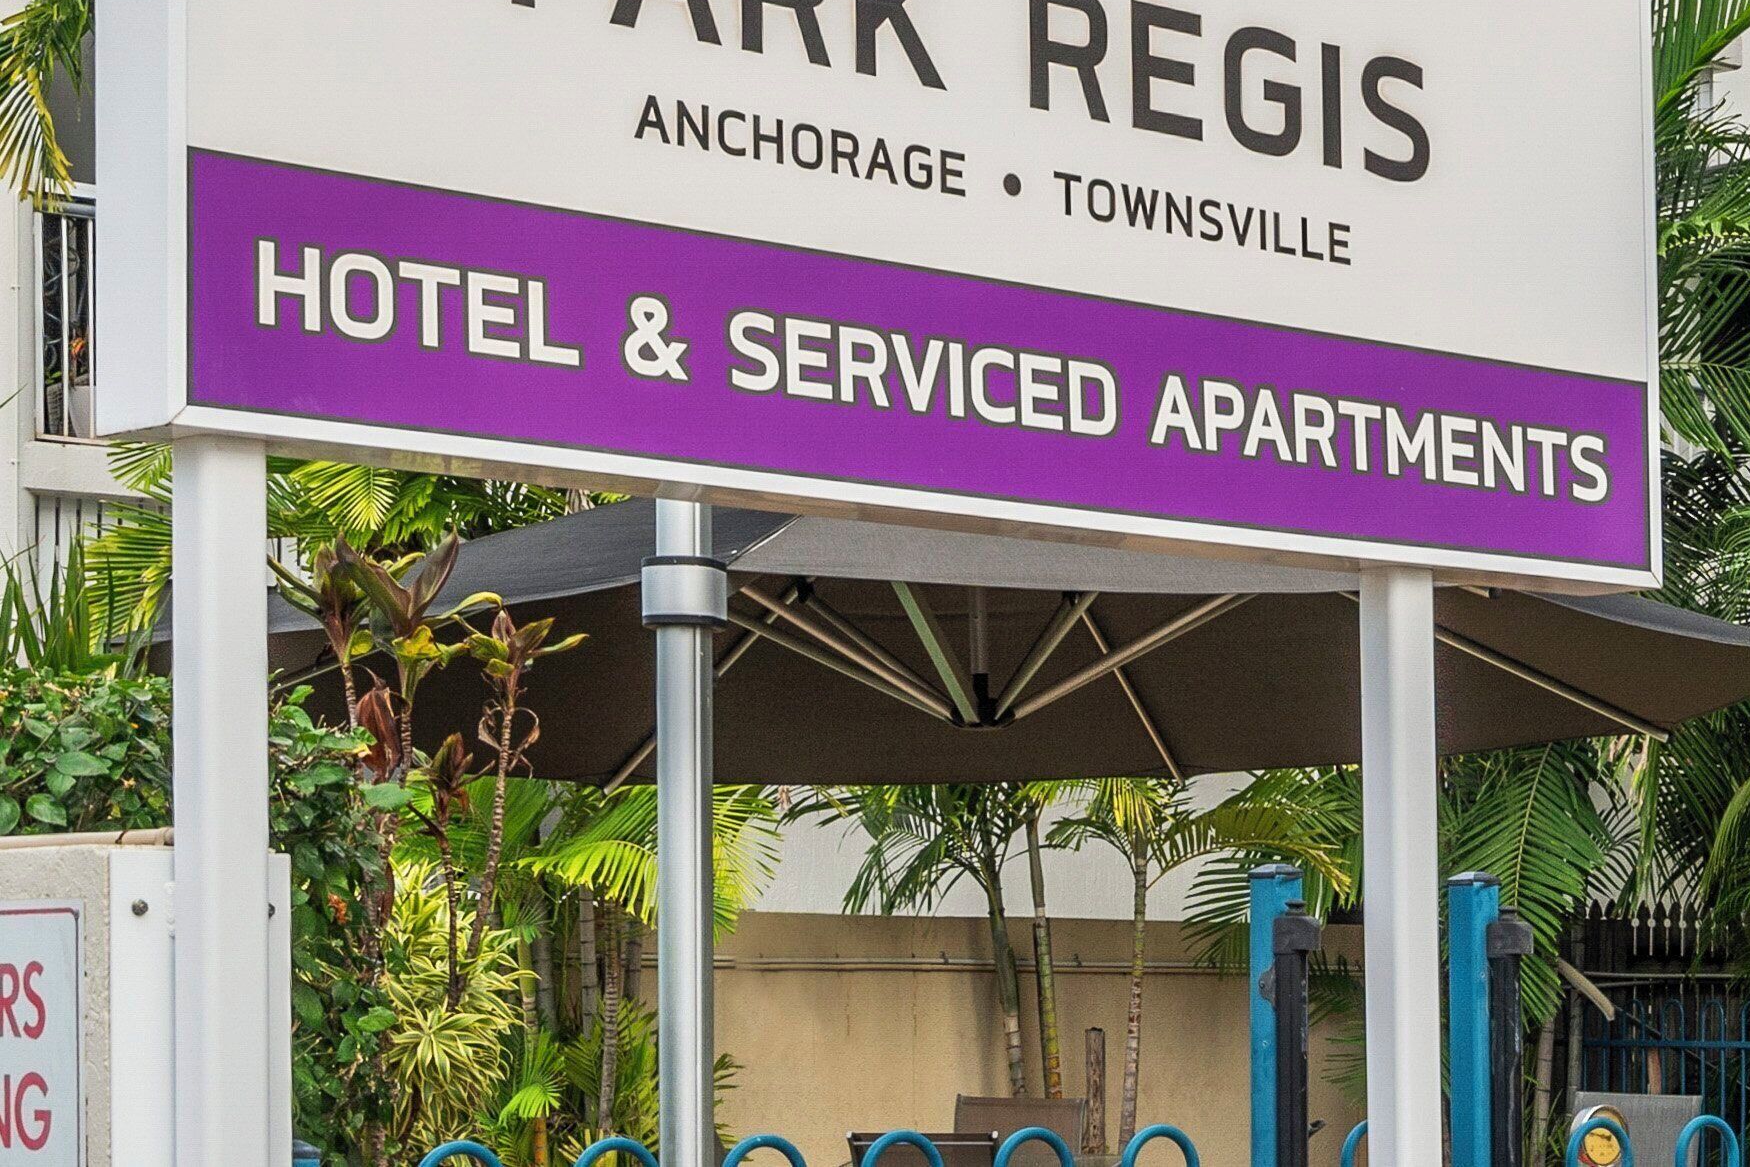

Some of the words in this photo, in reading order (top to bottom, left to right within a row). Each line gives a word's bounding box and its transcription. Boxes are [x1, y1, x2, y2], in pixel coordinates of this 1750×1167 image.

[633, 94, 967, 198] ANCHORAGE
[1052, 170, 1352, 266] TOWNSVILLE
[255, 238, 581, 368] HOTEL
[623, 295, 690, 382] &
[728, 310, 1118, 438] SERVICED
[1149, 374, 1609, 503] APARTMENTS
